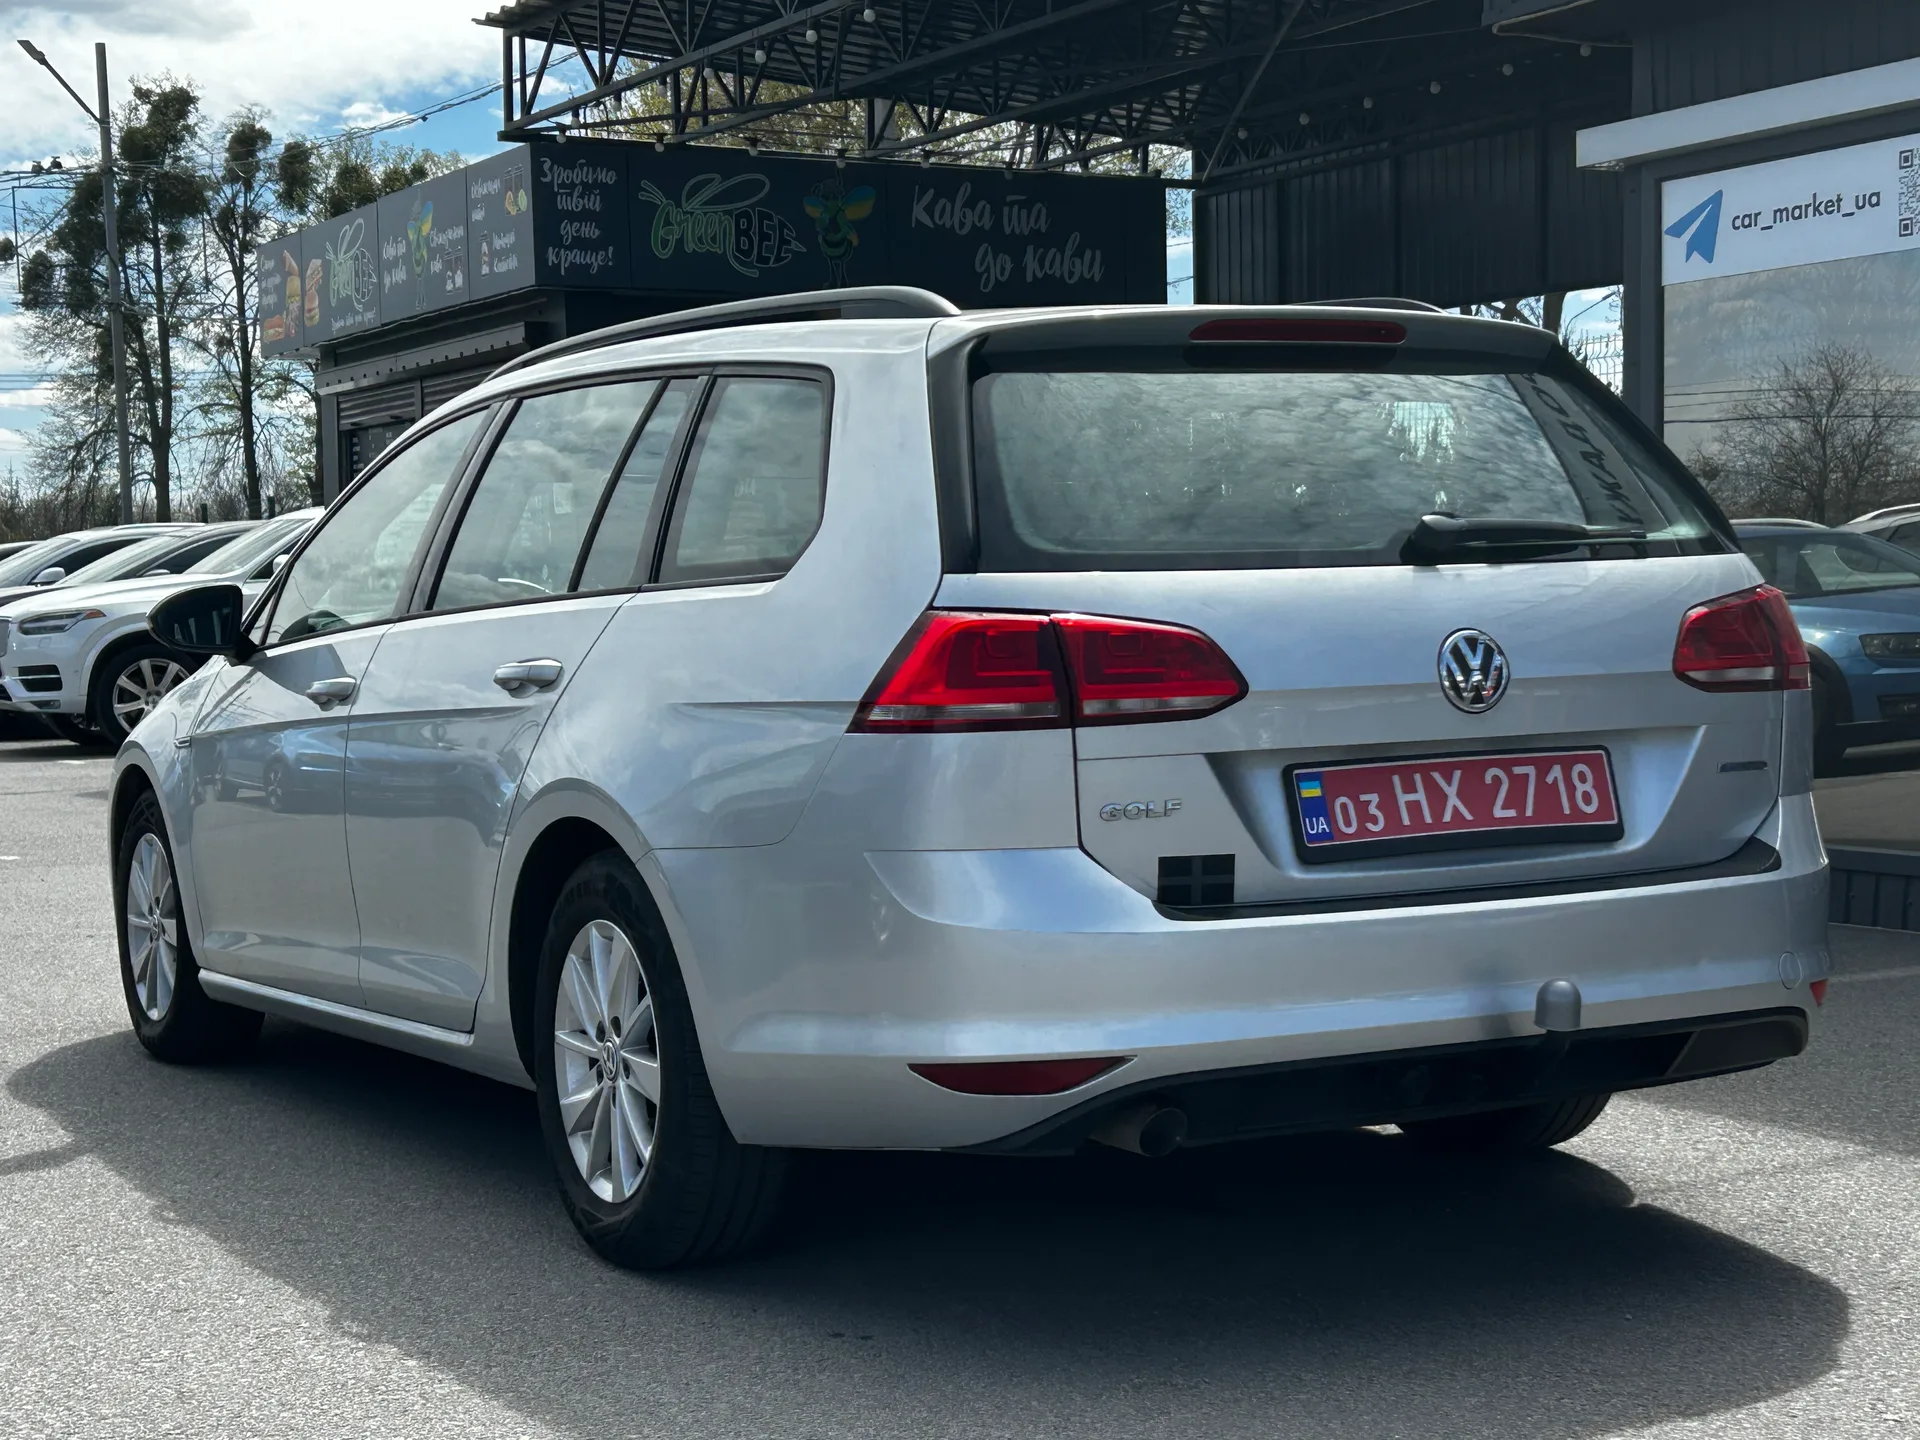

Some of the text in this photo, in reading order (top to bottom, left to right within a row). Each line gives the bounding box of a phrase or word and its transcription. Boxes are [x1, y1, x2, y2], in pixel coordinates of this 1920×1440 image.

[540, 157, 618, 192] Зробимо
[557, 185, 603, 212] твій
[911, 181, 1050, 235] Кава та
[1731, 191, 1882, 230] car_market_ua
[560, 219, 602, 245] день
[546, 246, 614, 275] краще!
[975, 232, 1105, 292] до кави
[1100, 798, 1182, 822] GOLF
[1333, 762, 1599, 835] 03 HX 2718
[1305, 816, 1330, 835] UA
